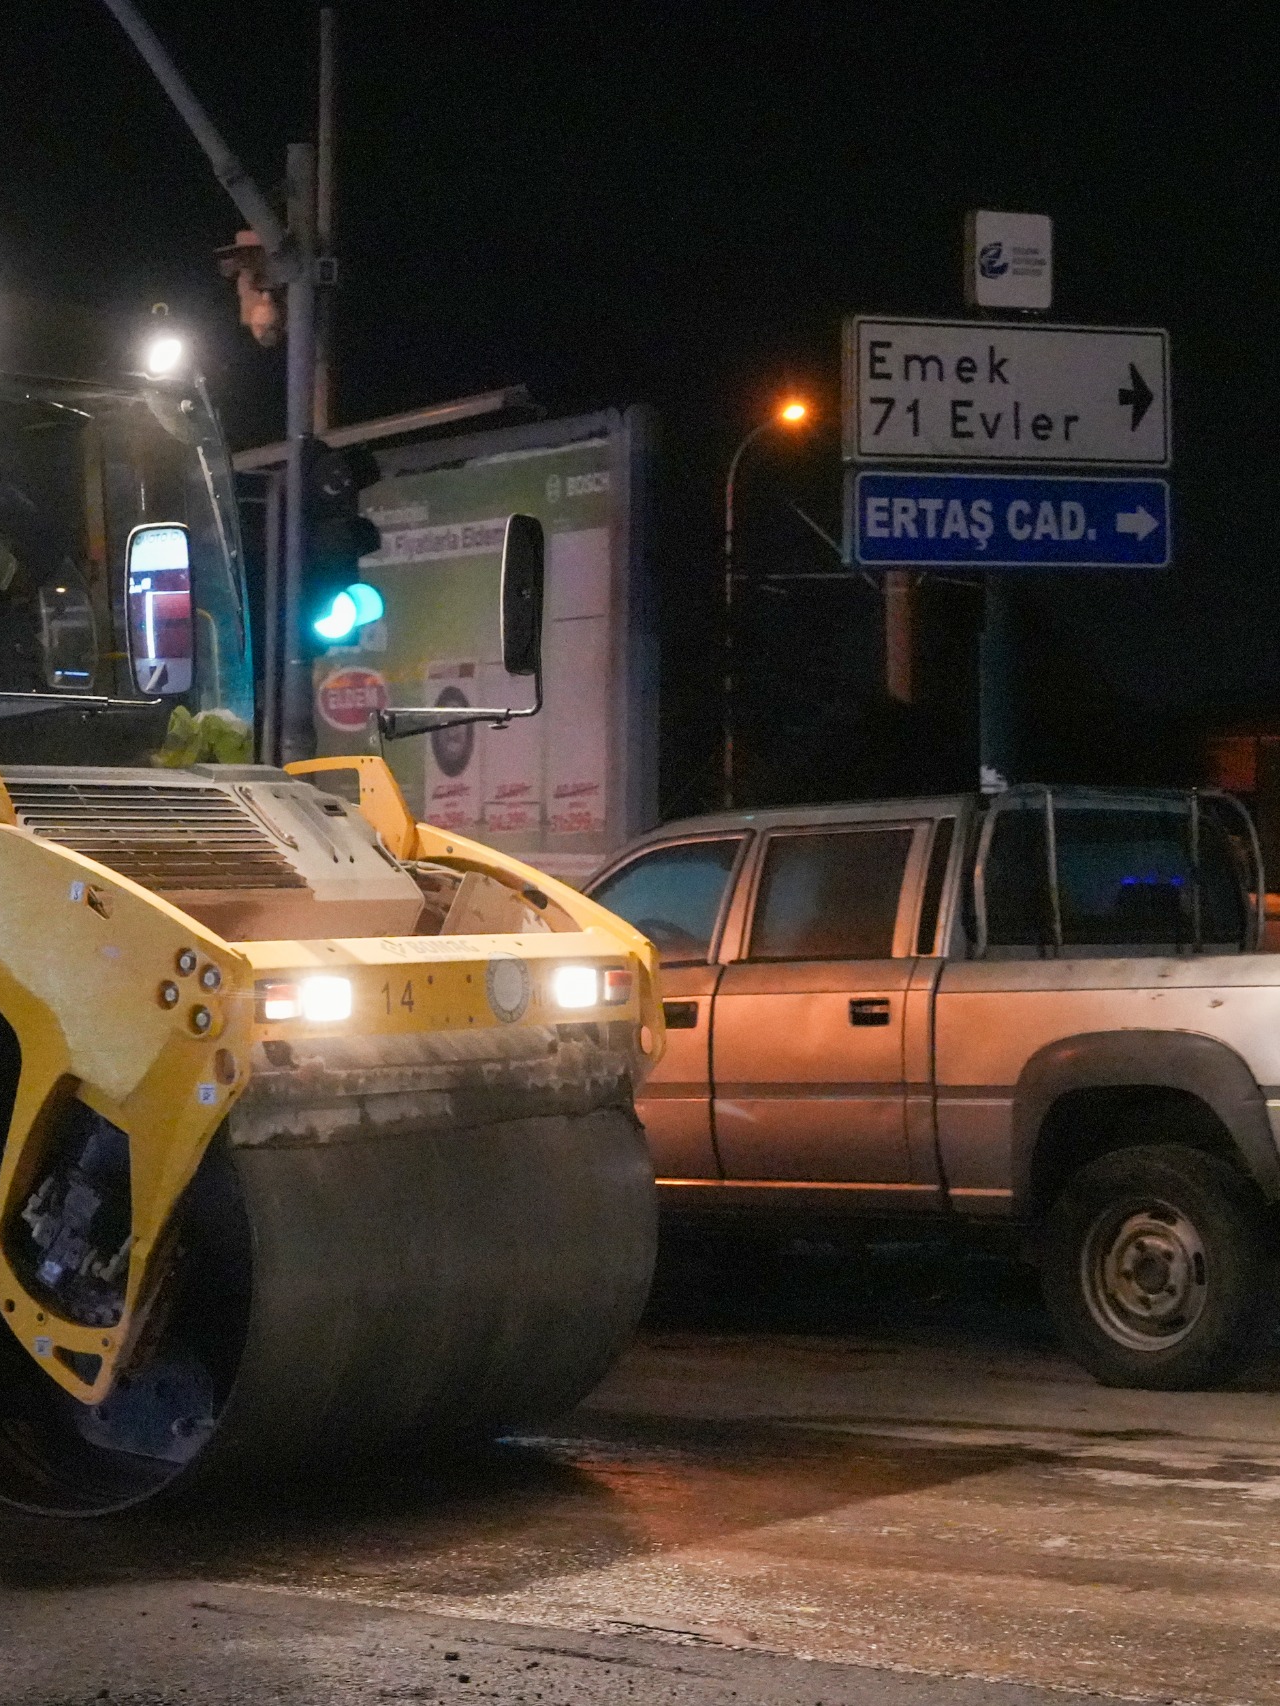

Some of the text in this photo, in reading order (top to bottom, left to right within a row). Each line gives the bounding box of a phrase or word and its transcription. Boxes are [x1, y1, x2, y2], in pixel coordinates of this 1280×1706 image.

[870, 341, 1010, 384] Emek
[870, 397, 1080, 441] 71 Evler
[866, 498, 1098, 550] ERTAŞ CAD.
[381, 979, 415, 1015] 14
